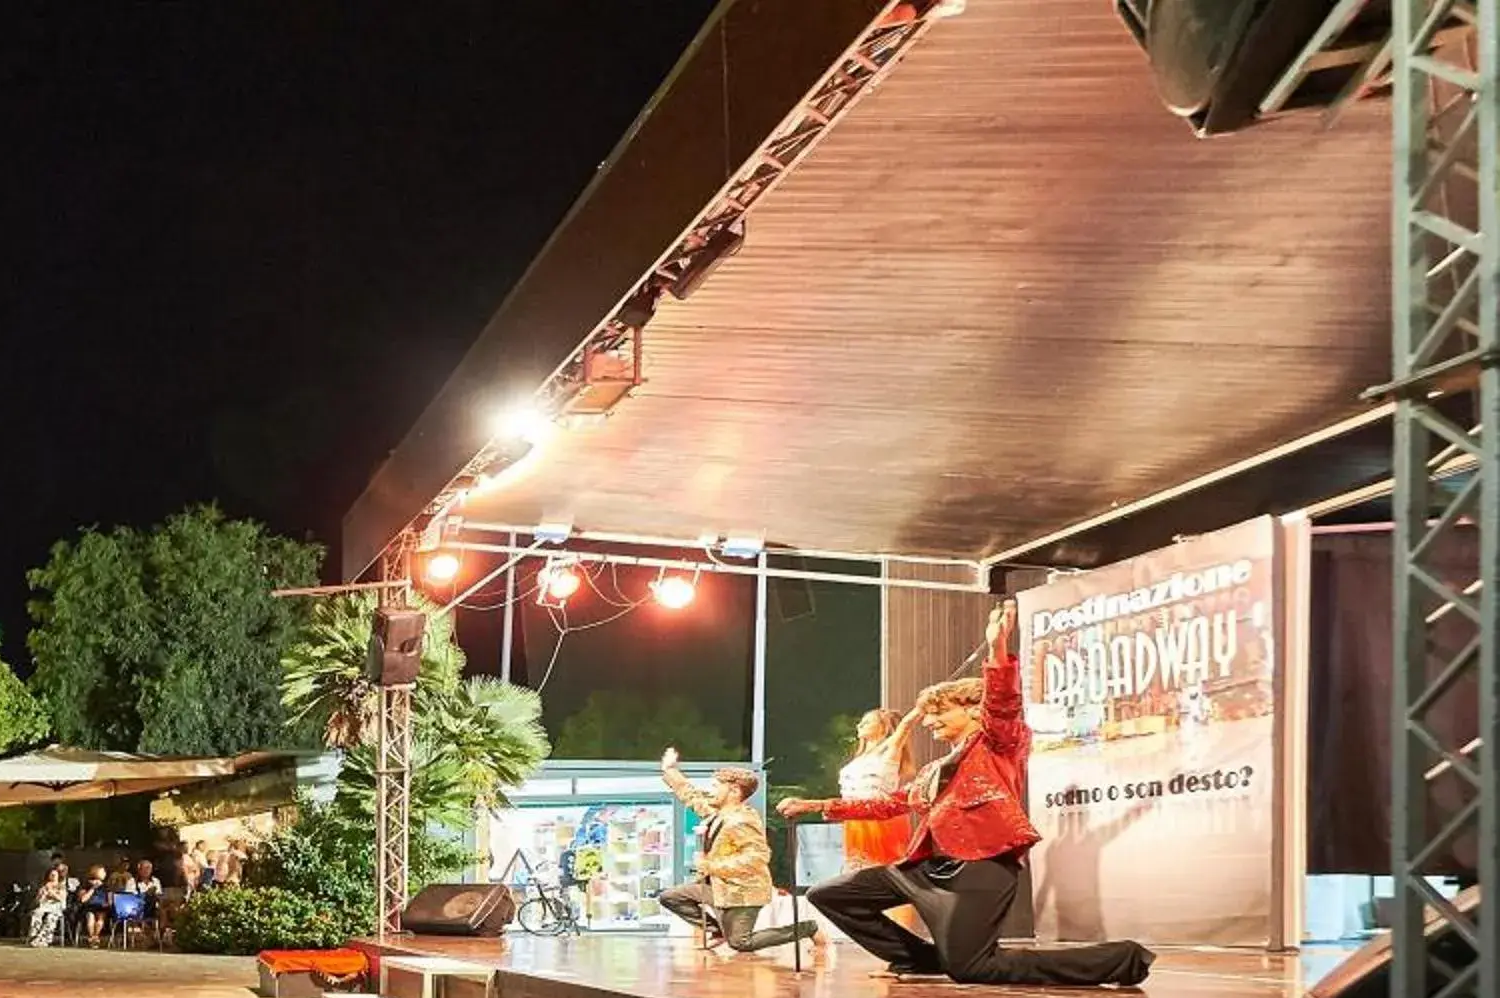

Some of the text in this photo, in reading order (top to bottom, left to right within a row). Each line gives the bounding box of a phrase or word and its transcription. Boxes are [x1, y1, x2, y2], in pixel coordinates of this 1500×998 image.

[1032, 559, 1252, 638] Destinazione
[1043, 609, 1236, 705] BROADWAY
[1107, 785, 1119, 801] o
[1168, 766, 1254, 795] desto?
